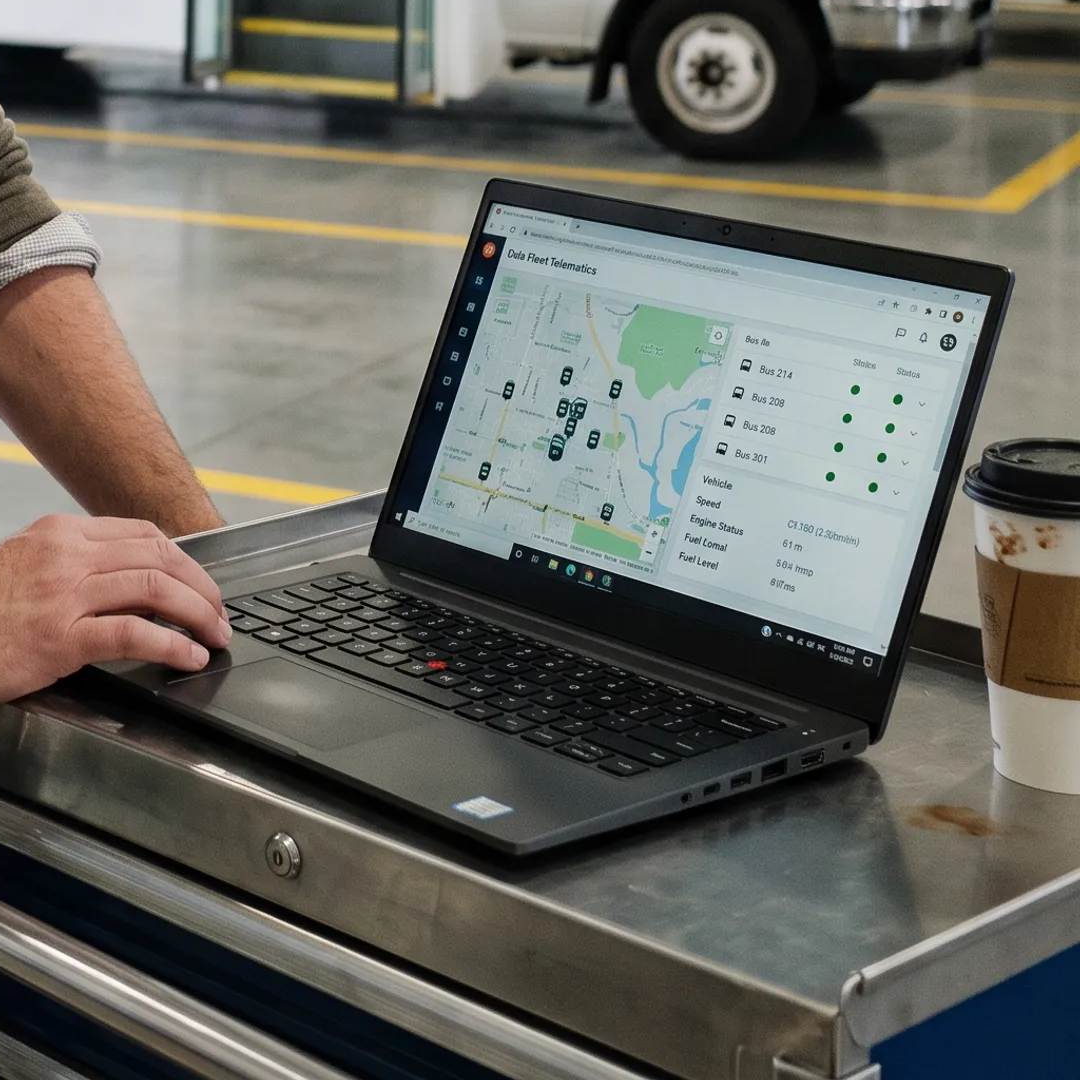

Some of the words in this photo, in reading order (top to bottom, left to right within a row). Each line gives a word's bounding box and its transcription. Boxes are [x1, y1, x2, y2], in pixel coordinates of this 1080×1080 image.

[527, 252, 549, 266] Fleet
[550, 257, 598, 276] Telematics
[759, 365, 776, 377] Bus
[777, 368, 793, 380] 214
[751, 393, 768, 405] Bus
[769, 396, 785, 408] 208
[742, 420, 759, 432] Bus
[760, 424, 777, 436] 208
[735, 449, 752, 461] Bus
[752, 453, 768, 464] 301
[702, 475, 733, 490] Vehicle
[696, 495, 722, 510] Speed
[689, 514, 717, 529] Engine
[718, 521, 744, 536] Status
[684, 532, 703, 545] Fuel
[678, 551, 697, 564] Fuel
[696, 556, 719, 570] Level
